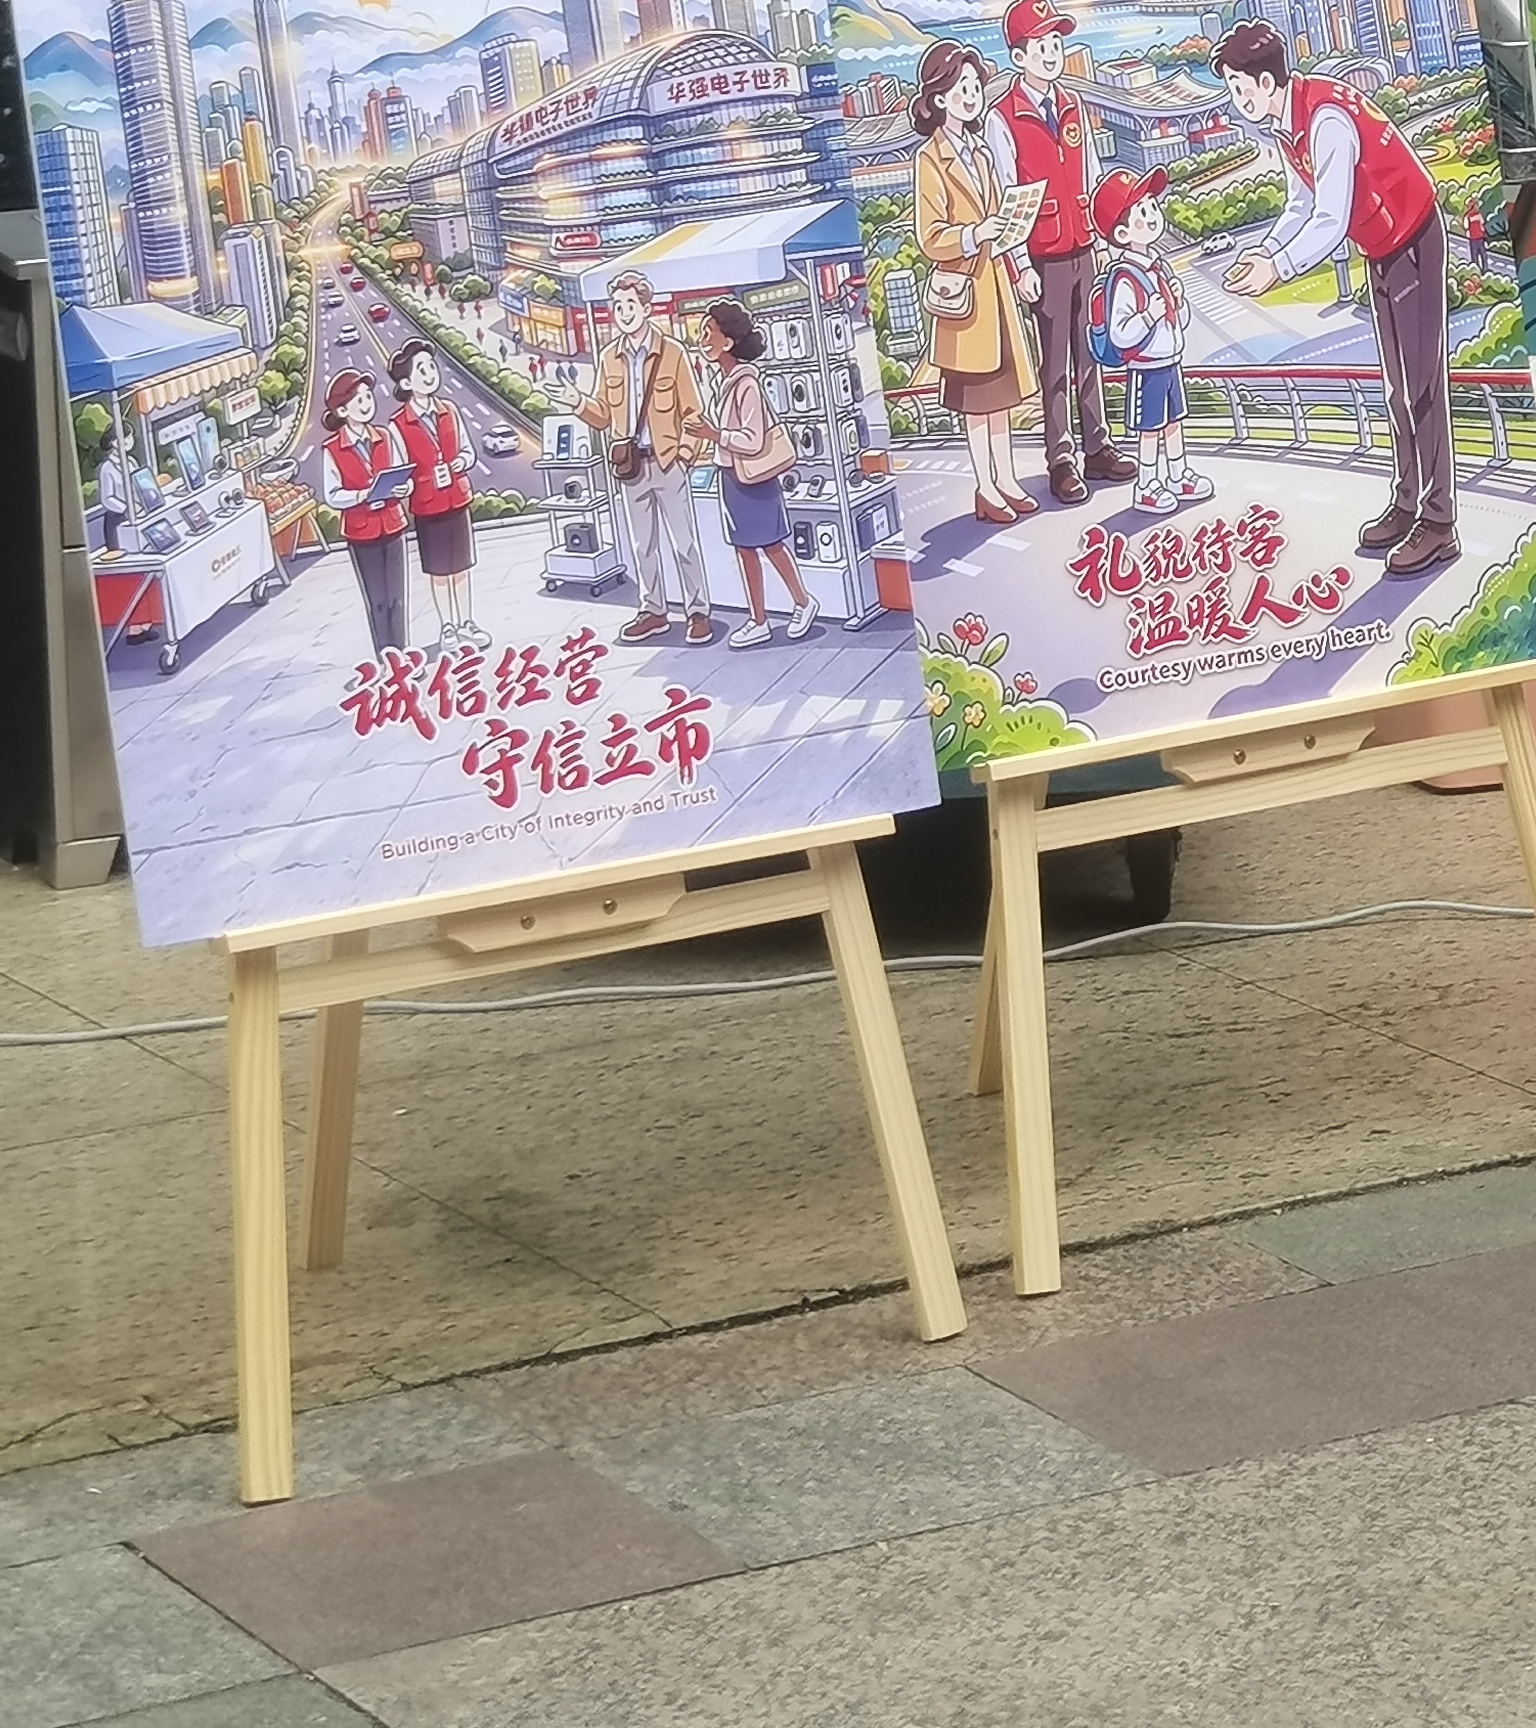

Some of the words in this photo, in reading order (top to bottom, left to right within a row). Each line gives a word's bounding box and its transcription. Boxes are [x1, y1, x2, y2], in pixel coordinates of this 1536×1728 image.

[1070, 504, 1285, 604] 礼貌待客
[1099, 658, 1193, 689] Courtesy
[1198, 648, 1266, 672] warms
[1271, 636, 1325, 660] every
[1331, 622, 1391, 648] heart.
[1128, 567, 1352, 654] 温暖人心
[339, 626, 608, 741] 诚信经营
[462, 688, 713, 809] 守信立市
[381, 834, 460, 860] Building
[464, 832, 477, 846] a
[481, 820, 520, 844] City
[524, 816, 543, 835] of
[549, 804, 626, 834] Integrity
[632, 794, 665, 817] and
[670, 787, 718, 807] Trust
